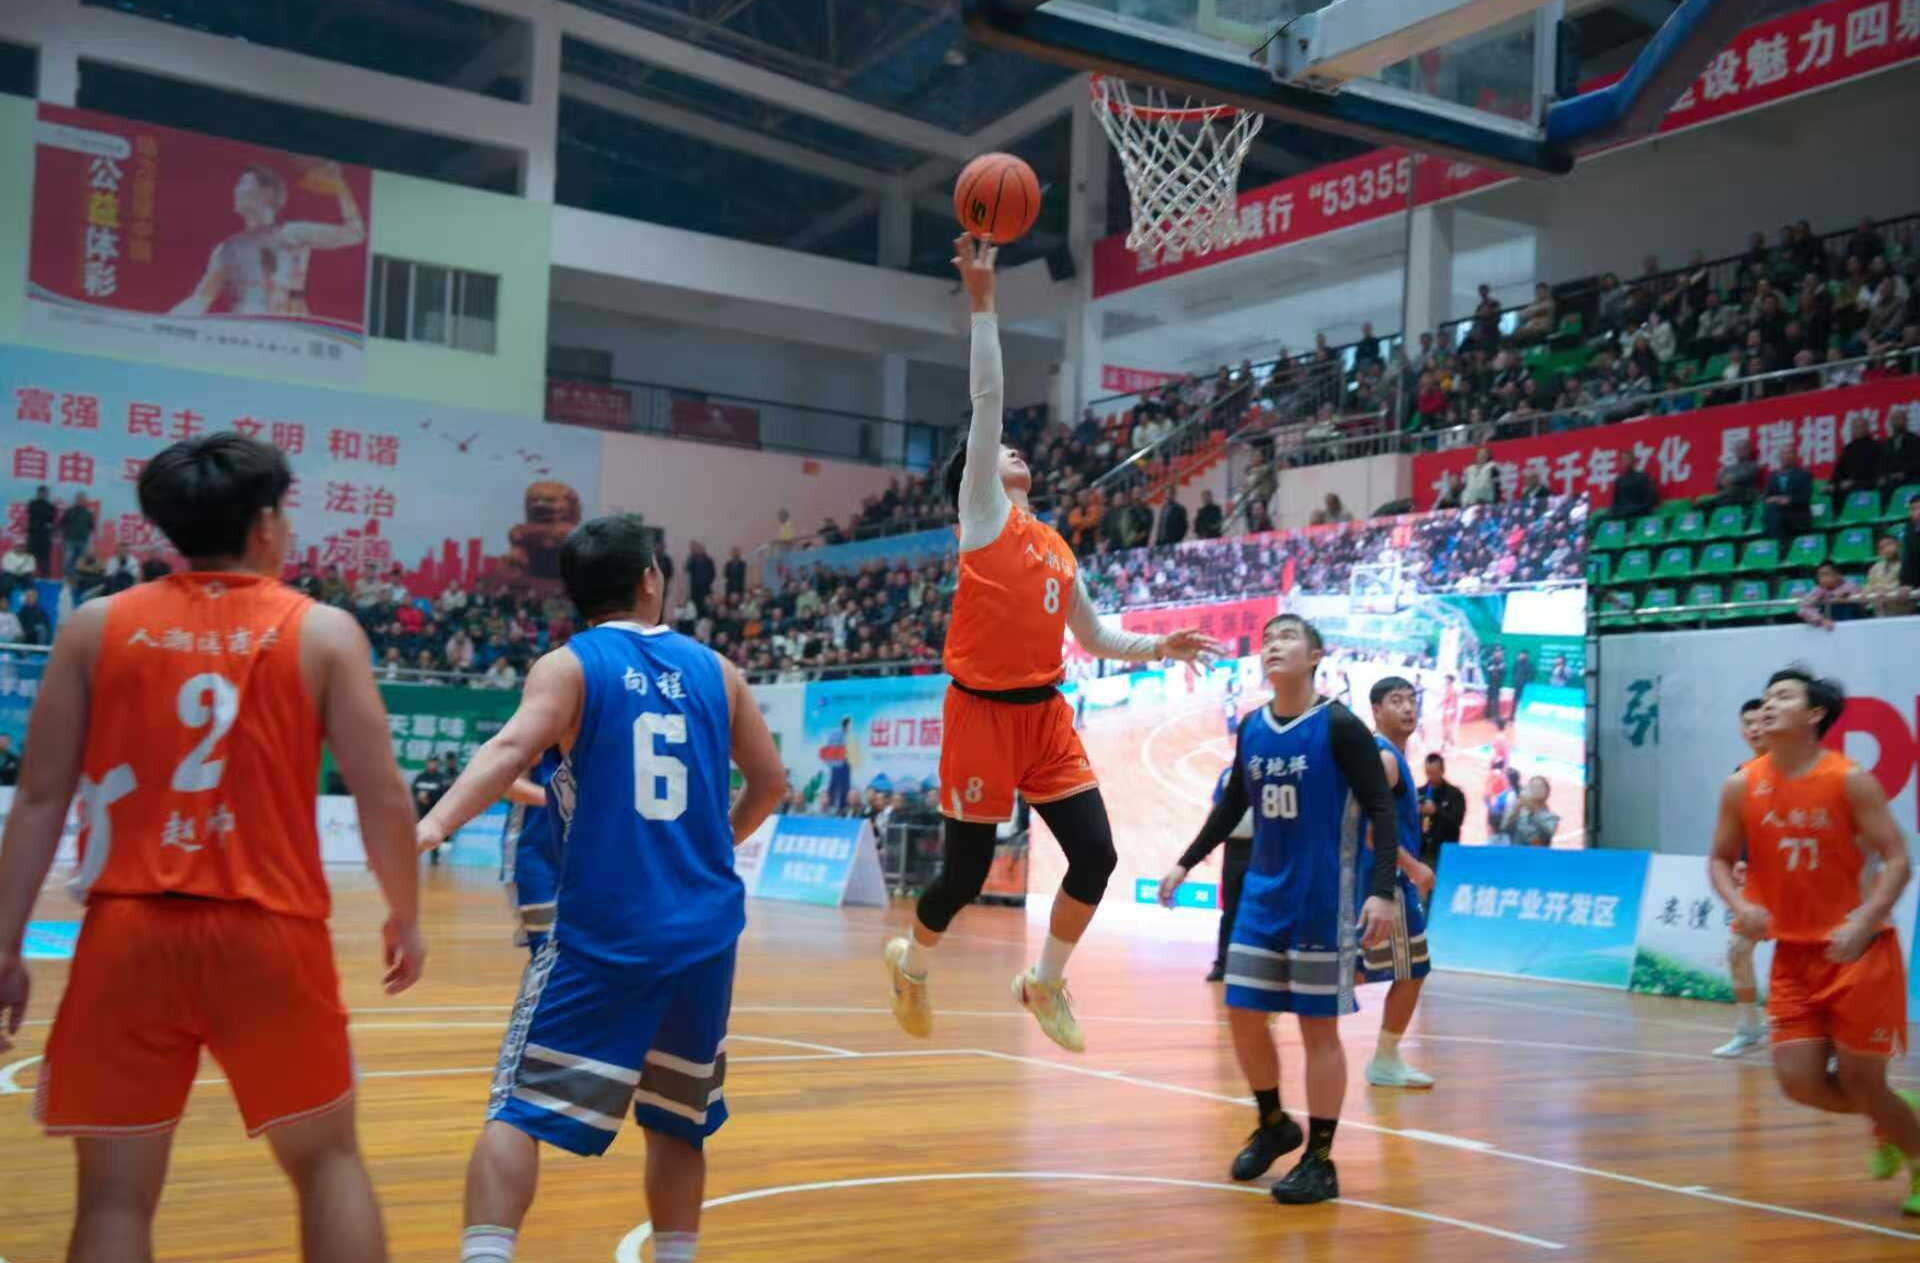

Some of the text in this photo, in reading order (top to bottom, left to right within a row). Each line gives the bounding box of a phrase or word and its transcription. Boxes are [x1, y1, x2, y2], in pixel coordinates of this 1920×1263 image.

[16, 387, 99, 429] 富强
[127, 402, 205, 440] 民主
[328, 428, 400, 466] 和谐
[13, 445, 95, 485] 自由
[325, 480, 395, 518] 法治
[1043, 576, 1060, 615] 8
[622, 666, 687, 700] 向程
[171, 672, 240, 792] 2
[633, 711, 688, 821] 6
[964, 777, 985, 803] 8
[1261, 784, 1298, 819] 80
[1450, 882, 1620, 928] 桑植产业开发区
